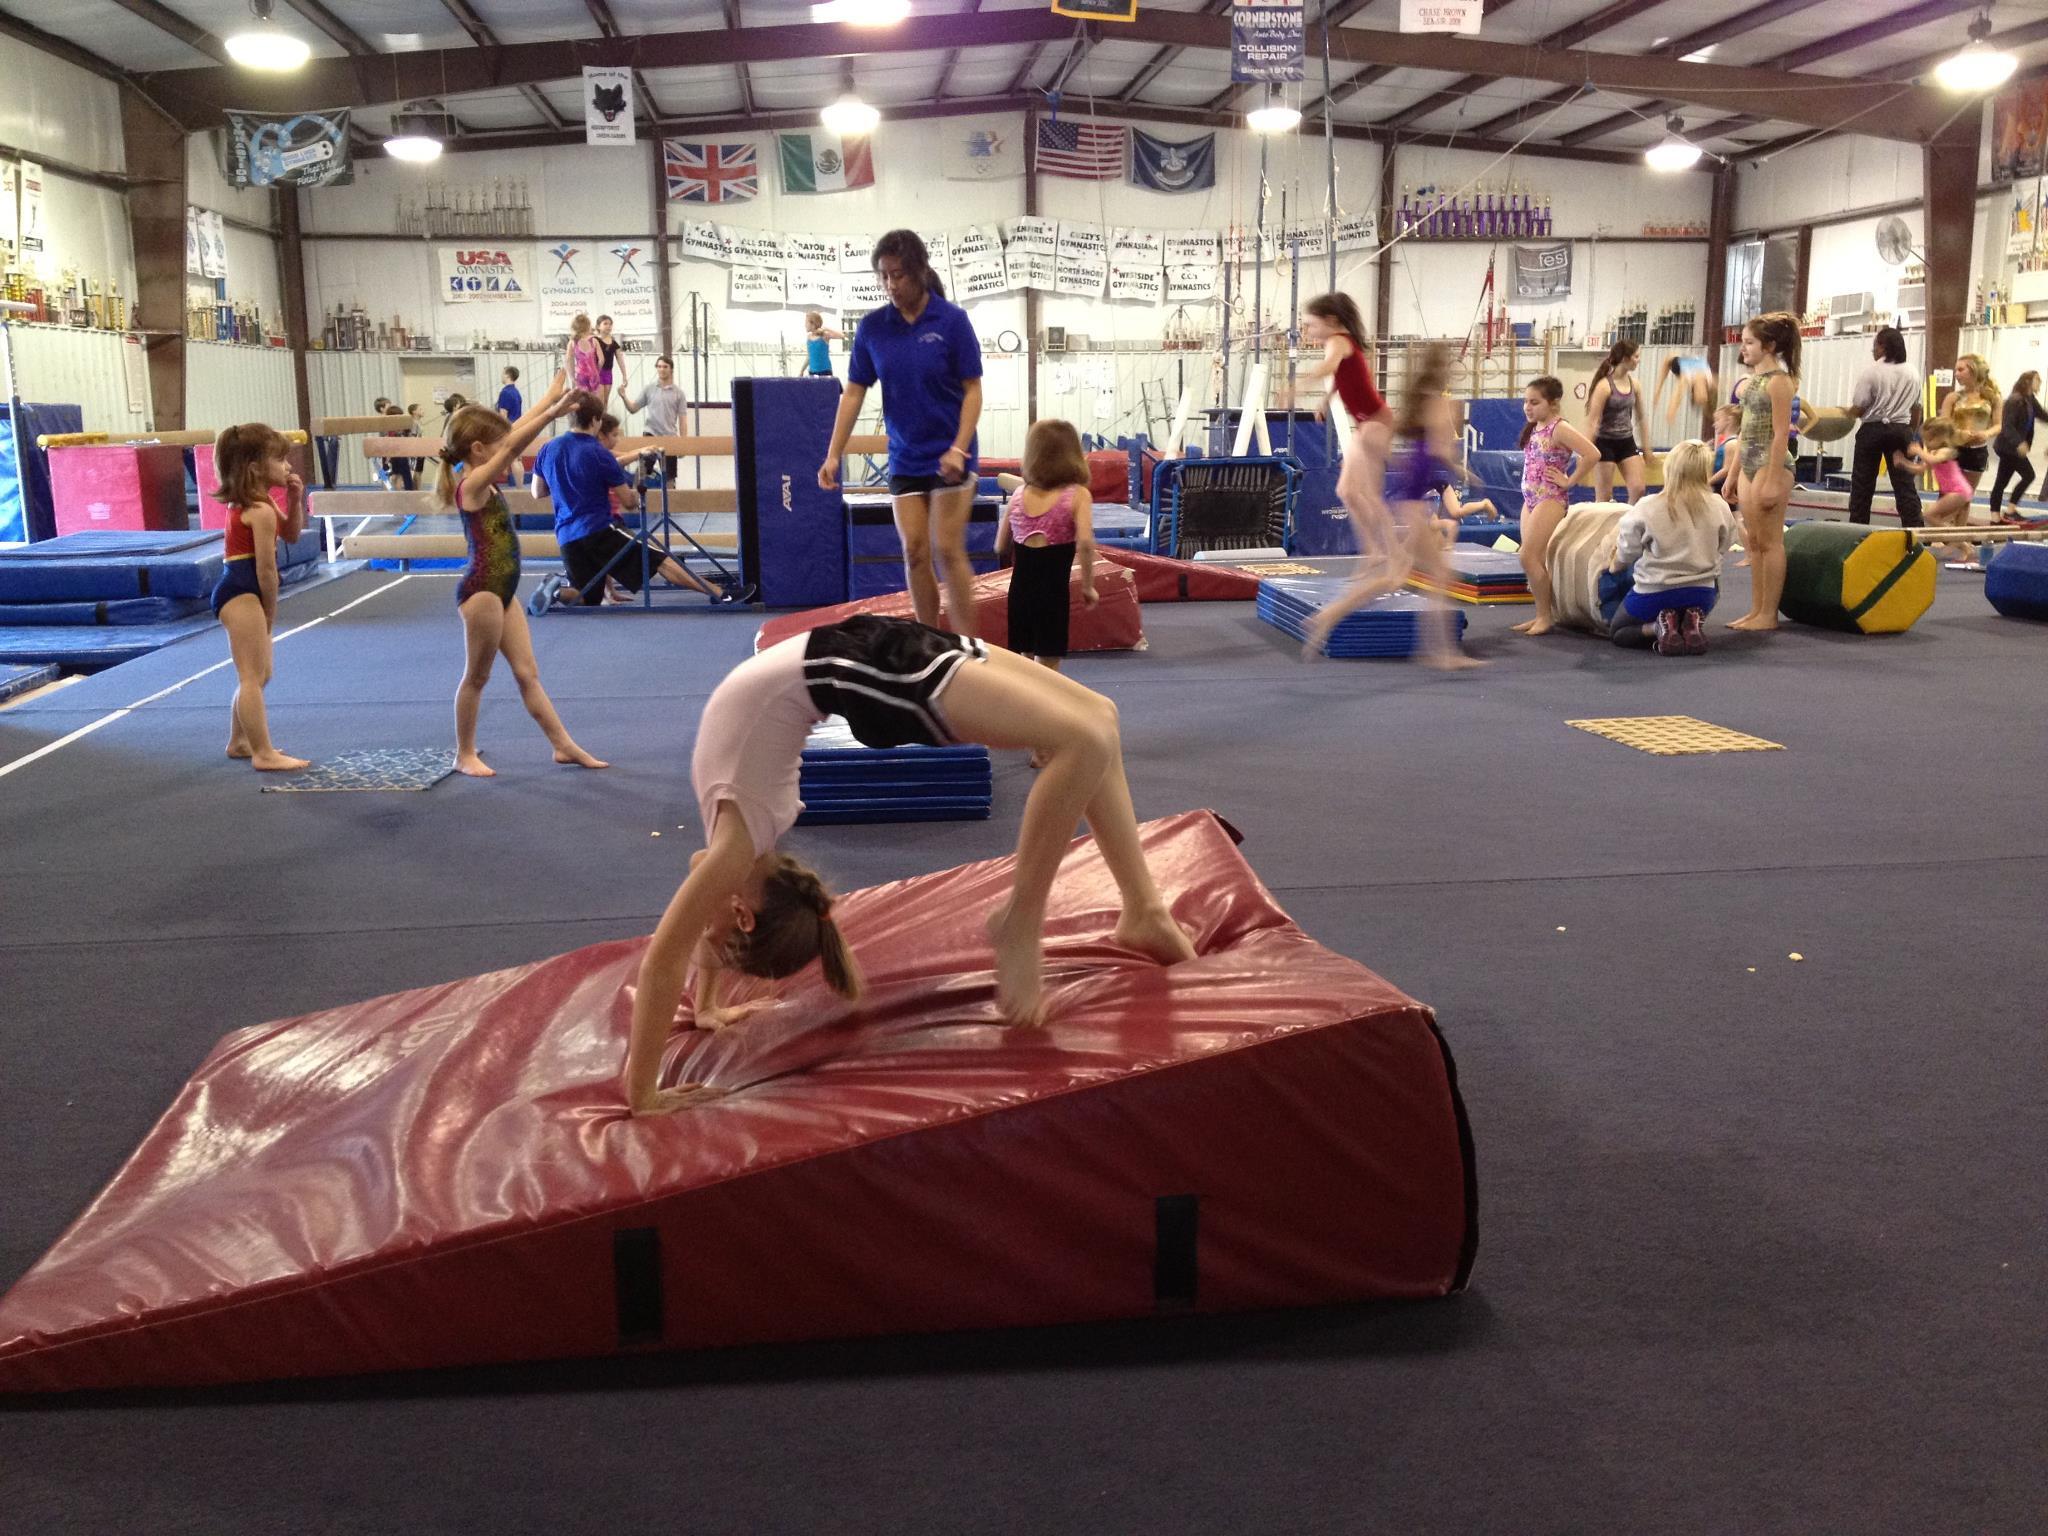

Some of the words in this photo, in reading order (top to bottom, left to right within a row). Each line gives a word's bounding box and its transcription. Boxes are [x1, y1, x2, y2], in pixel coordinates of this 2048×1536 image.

[1233, 11, 1303, 28] CORNERSTONE
[1239, 44, 1297, 53] COLLISION
[1166, 238, 1214, 246] GYMNASTICS
[734, 246, 784, 259] GYMNASTICS
[456, 250, 512, 266] USA
[457, 266, 514, 275] GYMNASTICS
[559, 278, 576, 286] USA
[621, 278, 638, 286] USA
[1059, 276, 1100, 287] GYMNASTICS
[542, 286, 594, 295] GYMNASTICS
[605, 286, 657, 297] GYMNASTICS
